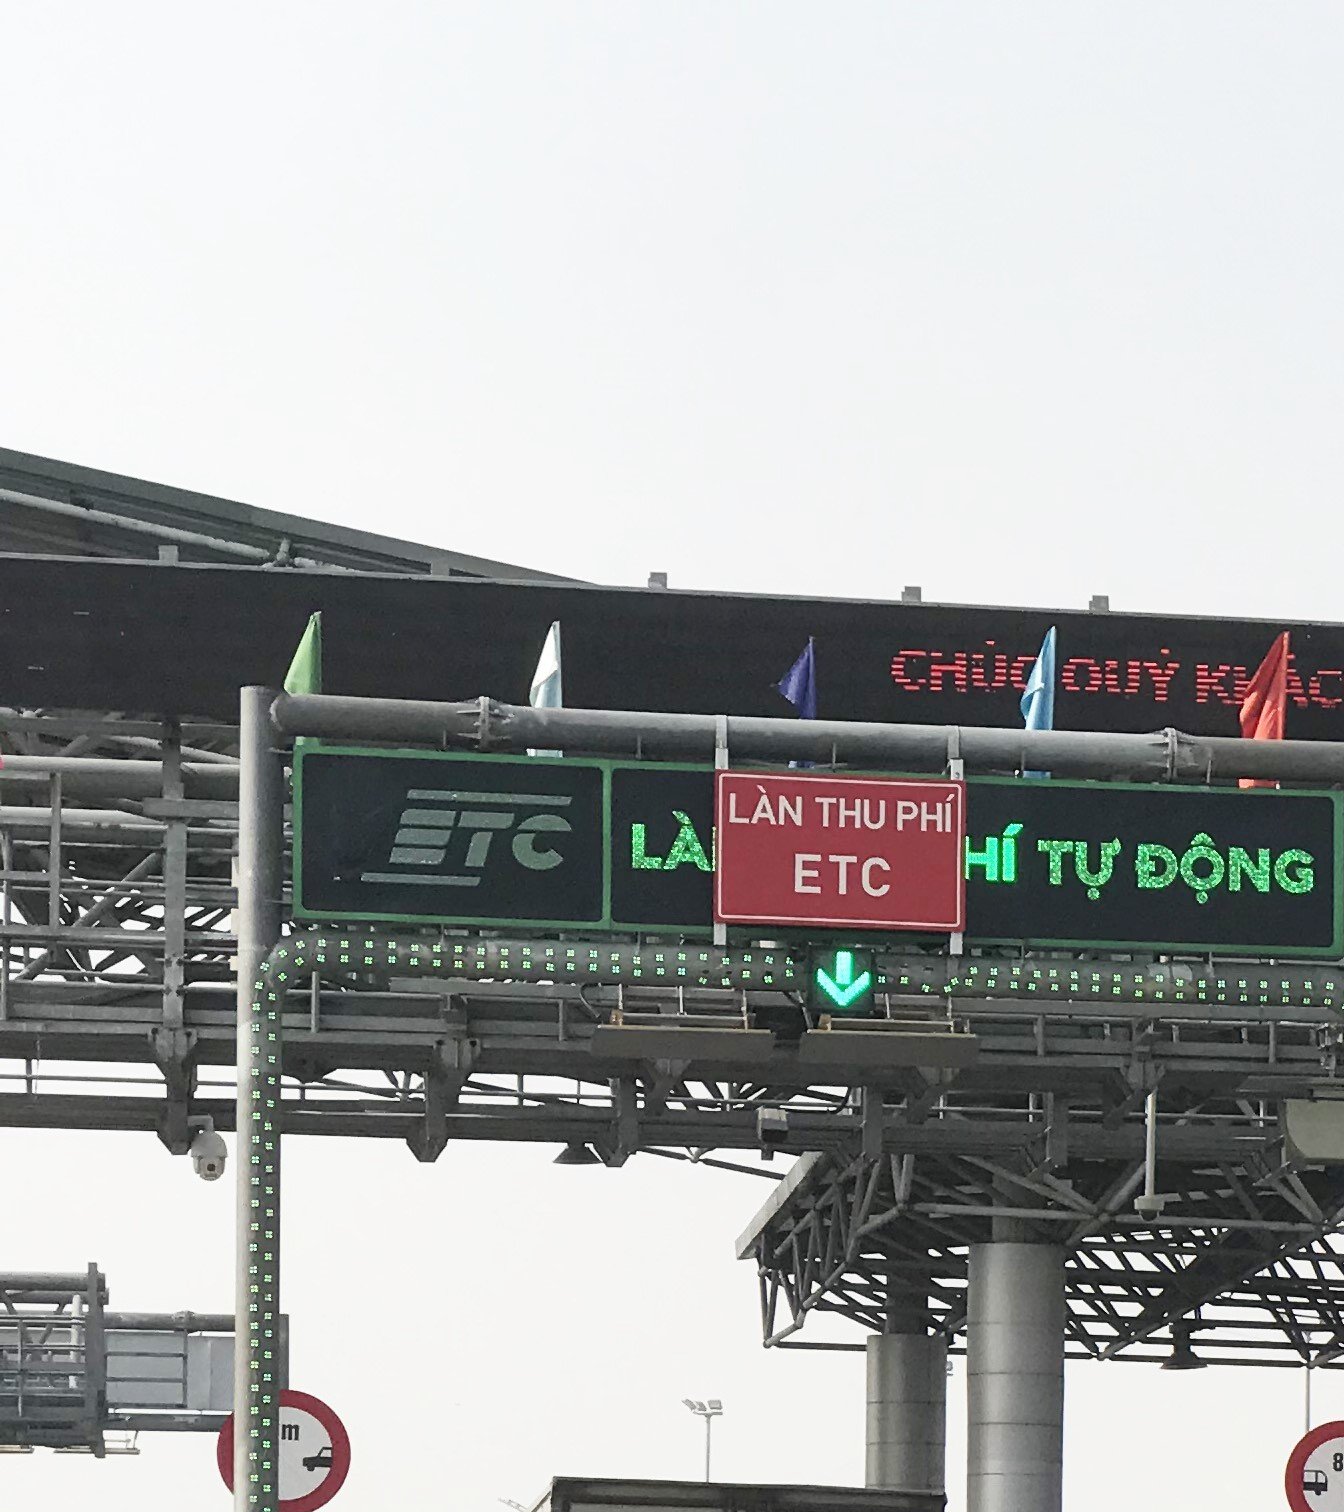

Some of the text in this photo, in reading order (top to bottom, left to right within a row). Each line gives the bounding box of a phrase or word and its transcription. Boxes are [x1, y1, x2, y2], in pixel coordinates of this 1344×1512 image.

[729, 785, 953, 833] LÀN THU PHÍ
[389, 808, 572, 871] ETC
[631, 810, 1315, 904] LÀ HÍ TỰ ĐỘNG
[794, 853, 892, 897] ETC
[281, 1423, 300, 1441] m
